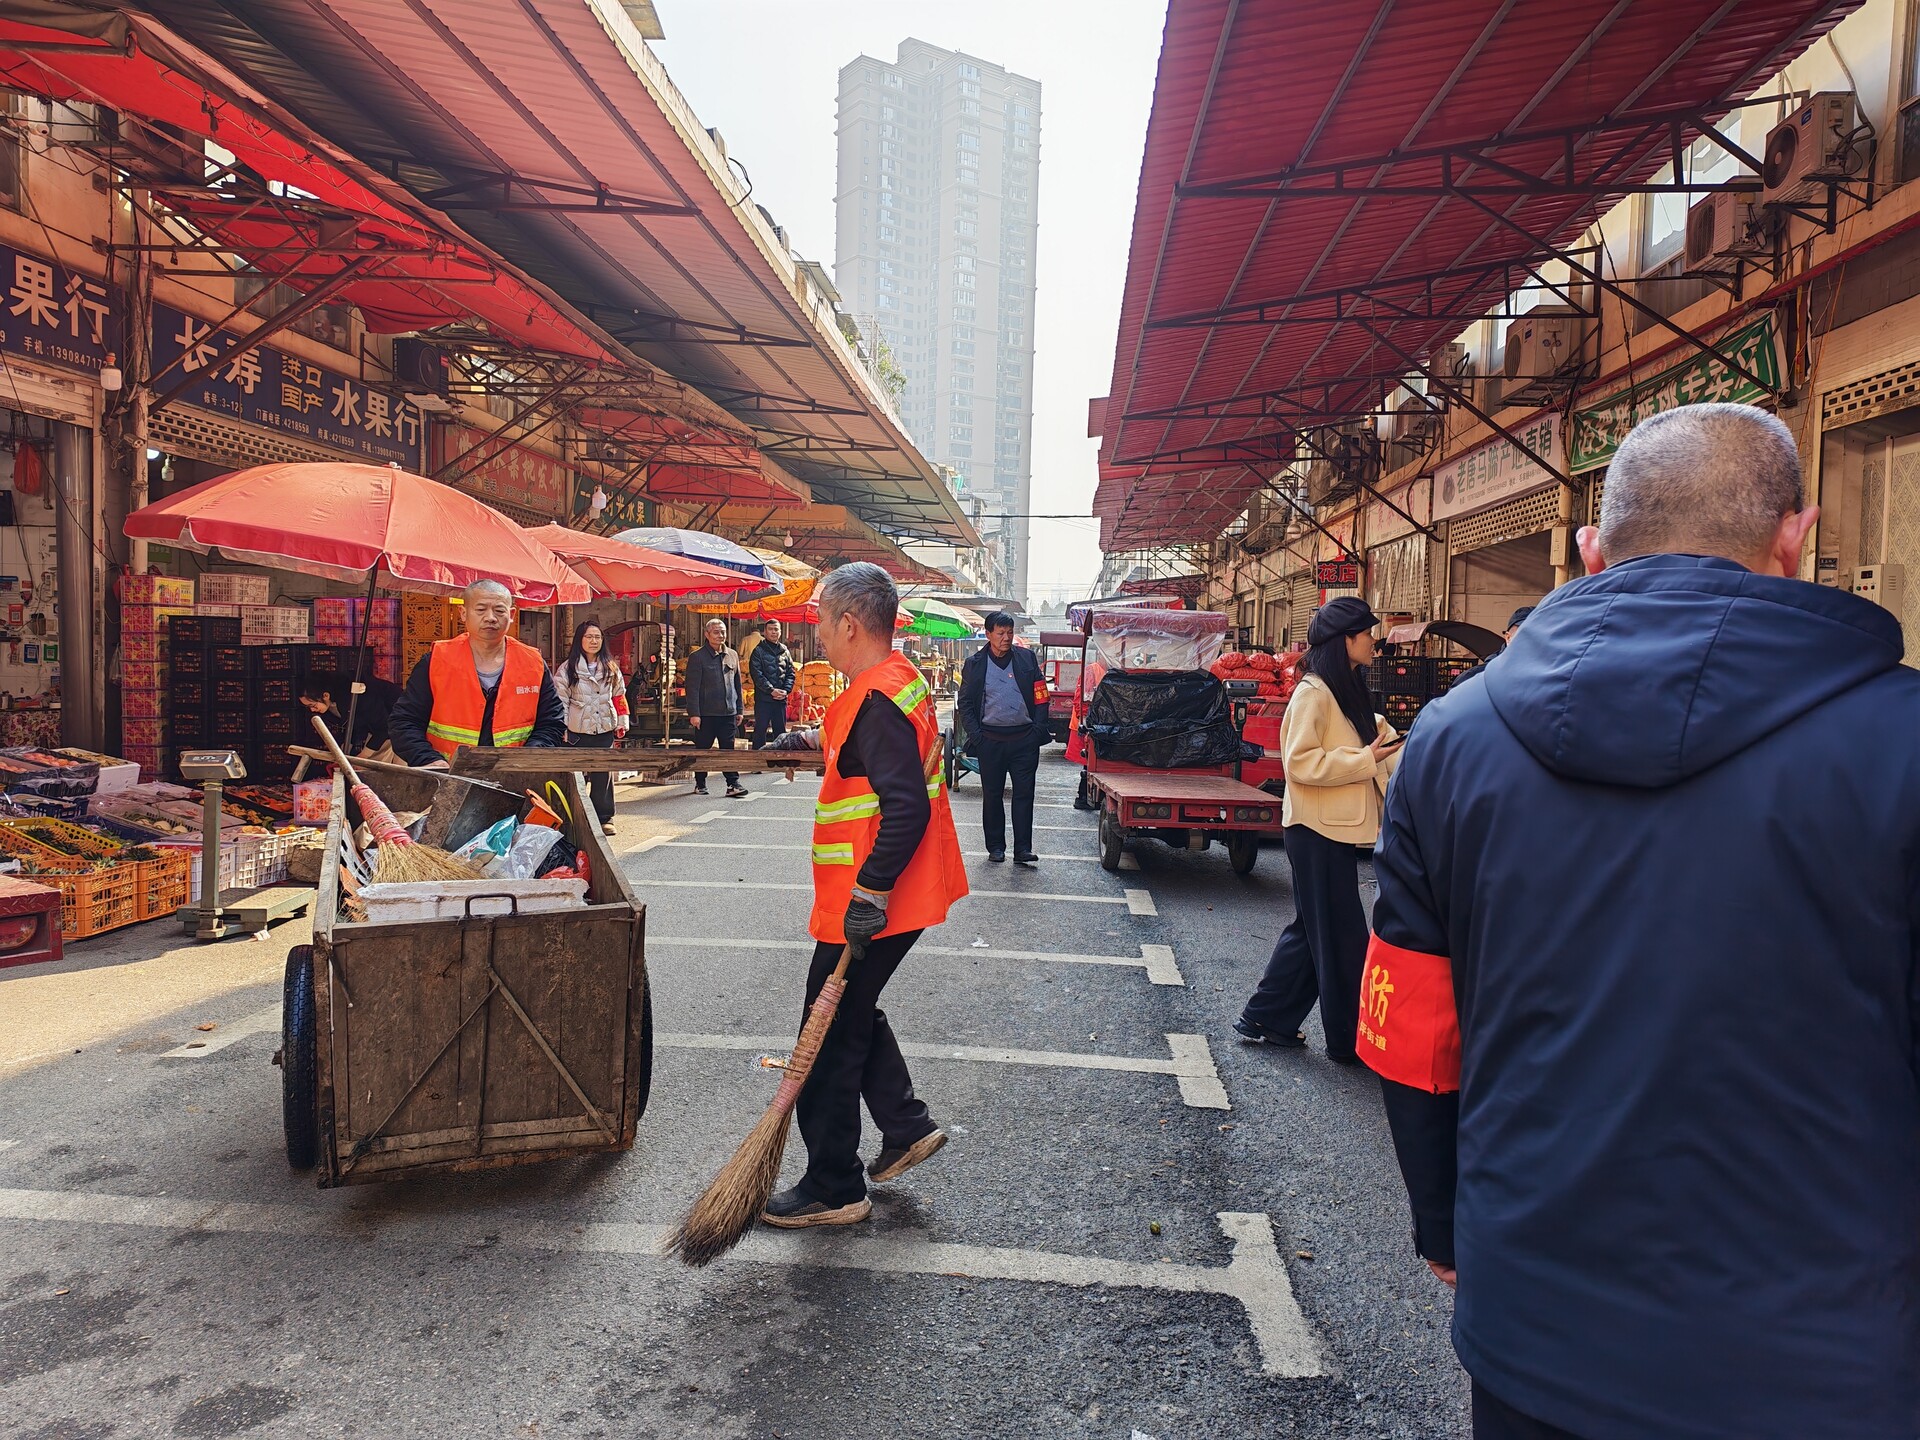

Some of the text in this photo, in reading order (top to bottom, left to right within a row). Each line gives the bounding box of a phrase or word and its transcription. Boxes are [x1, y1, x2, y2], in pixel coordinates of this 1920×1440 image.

[0, 253, 110, 345] 果行
[281, 354, 323, 389] 进口
[281, 382, 325, 415] 国产
[331, 379, 420, 446] 水果行
[1318, 563, 1357, 583] 花店
[1360, 965, 1394, 1028] 防
